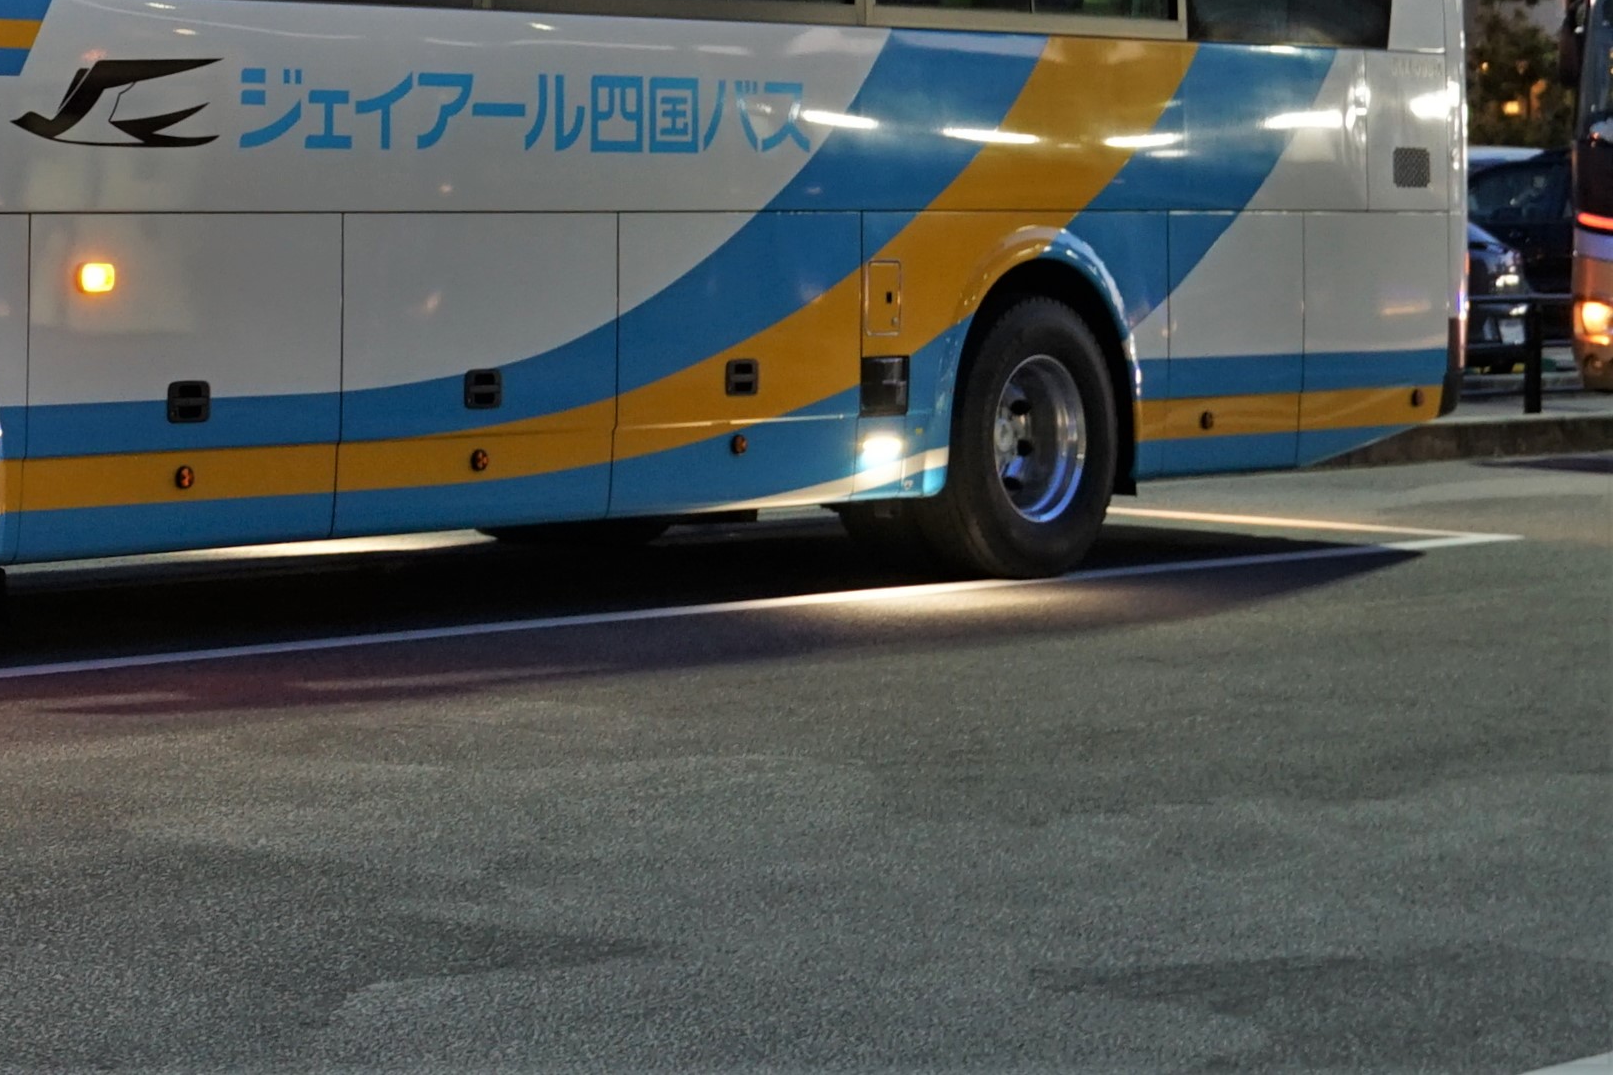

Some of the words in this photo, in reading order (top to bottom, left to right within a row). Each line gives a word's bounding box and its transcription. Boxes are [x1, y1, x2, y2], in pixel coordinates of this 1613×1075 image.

[239, 67, 811, 153] ジェイアール四国バス
